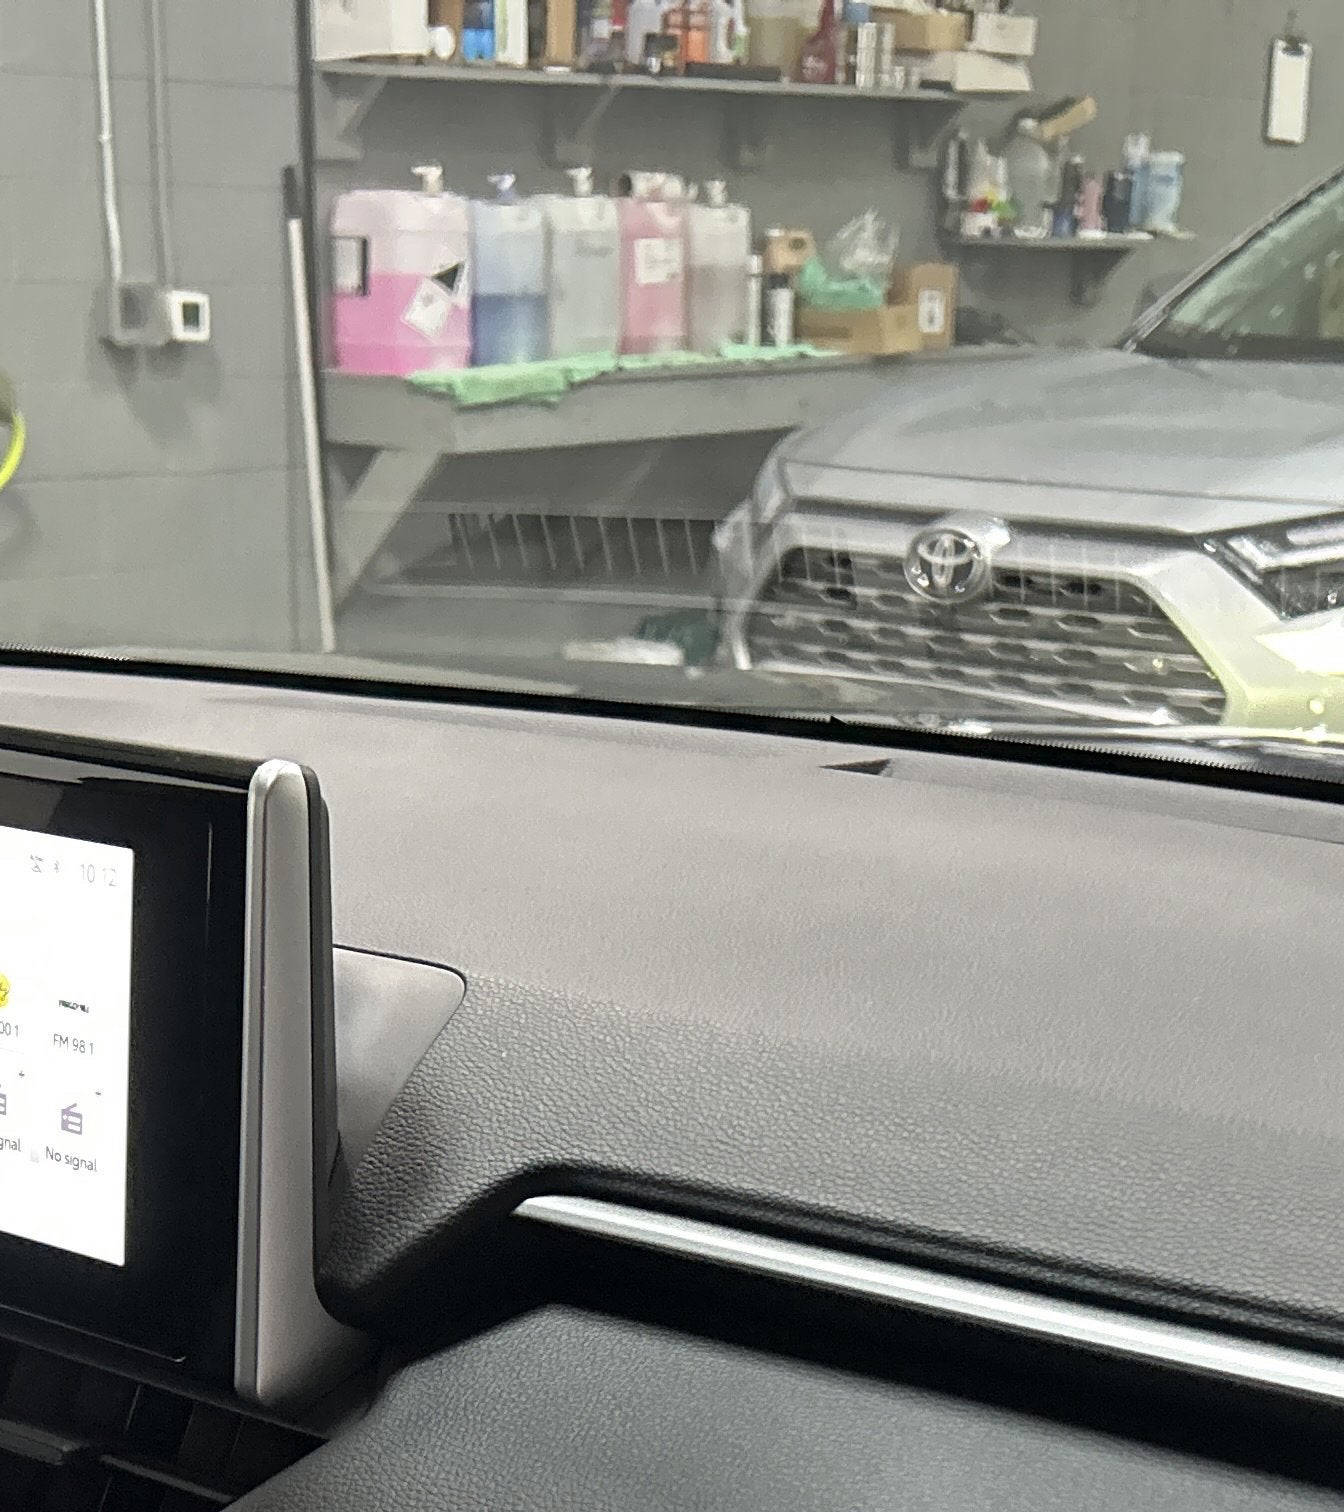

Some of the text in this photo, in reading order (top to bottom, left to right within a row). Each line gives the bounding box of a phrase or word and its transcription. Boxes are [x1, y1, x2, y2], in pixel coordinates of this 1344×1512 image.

[53, 1033, 69, 1049] FM
[45, 1145, 98, 1173] No signal
